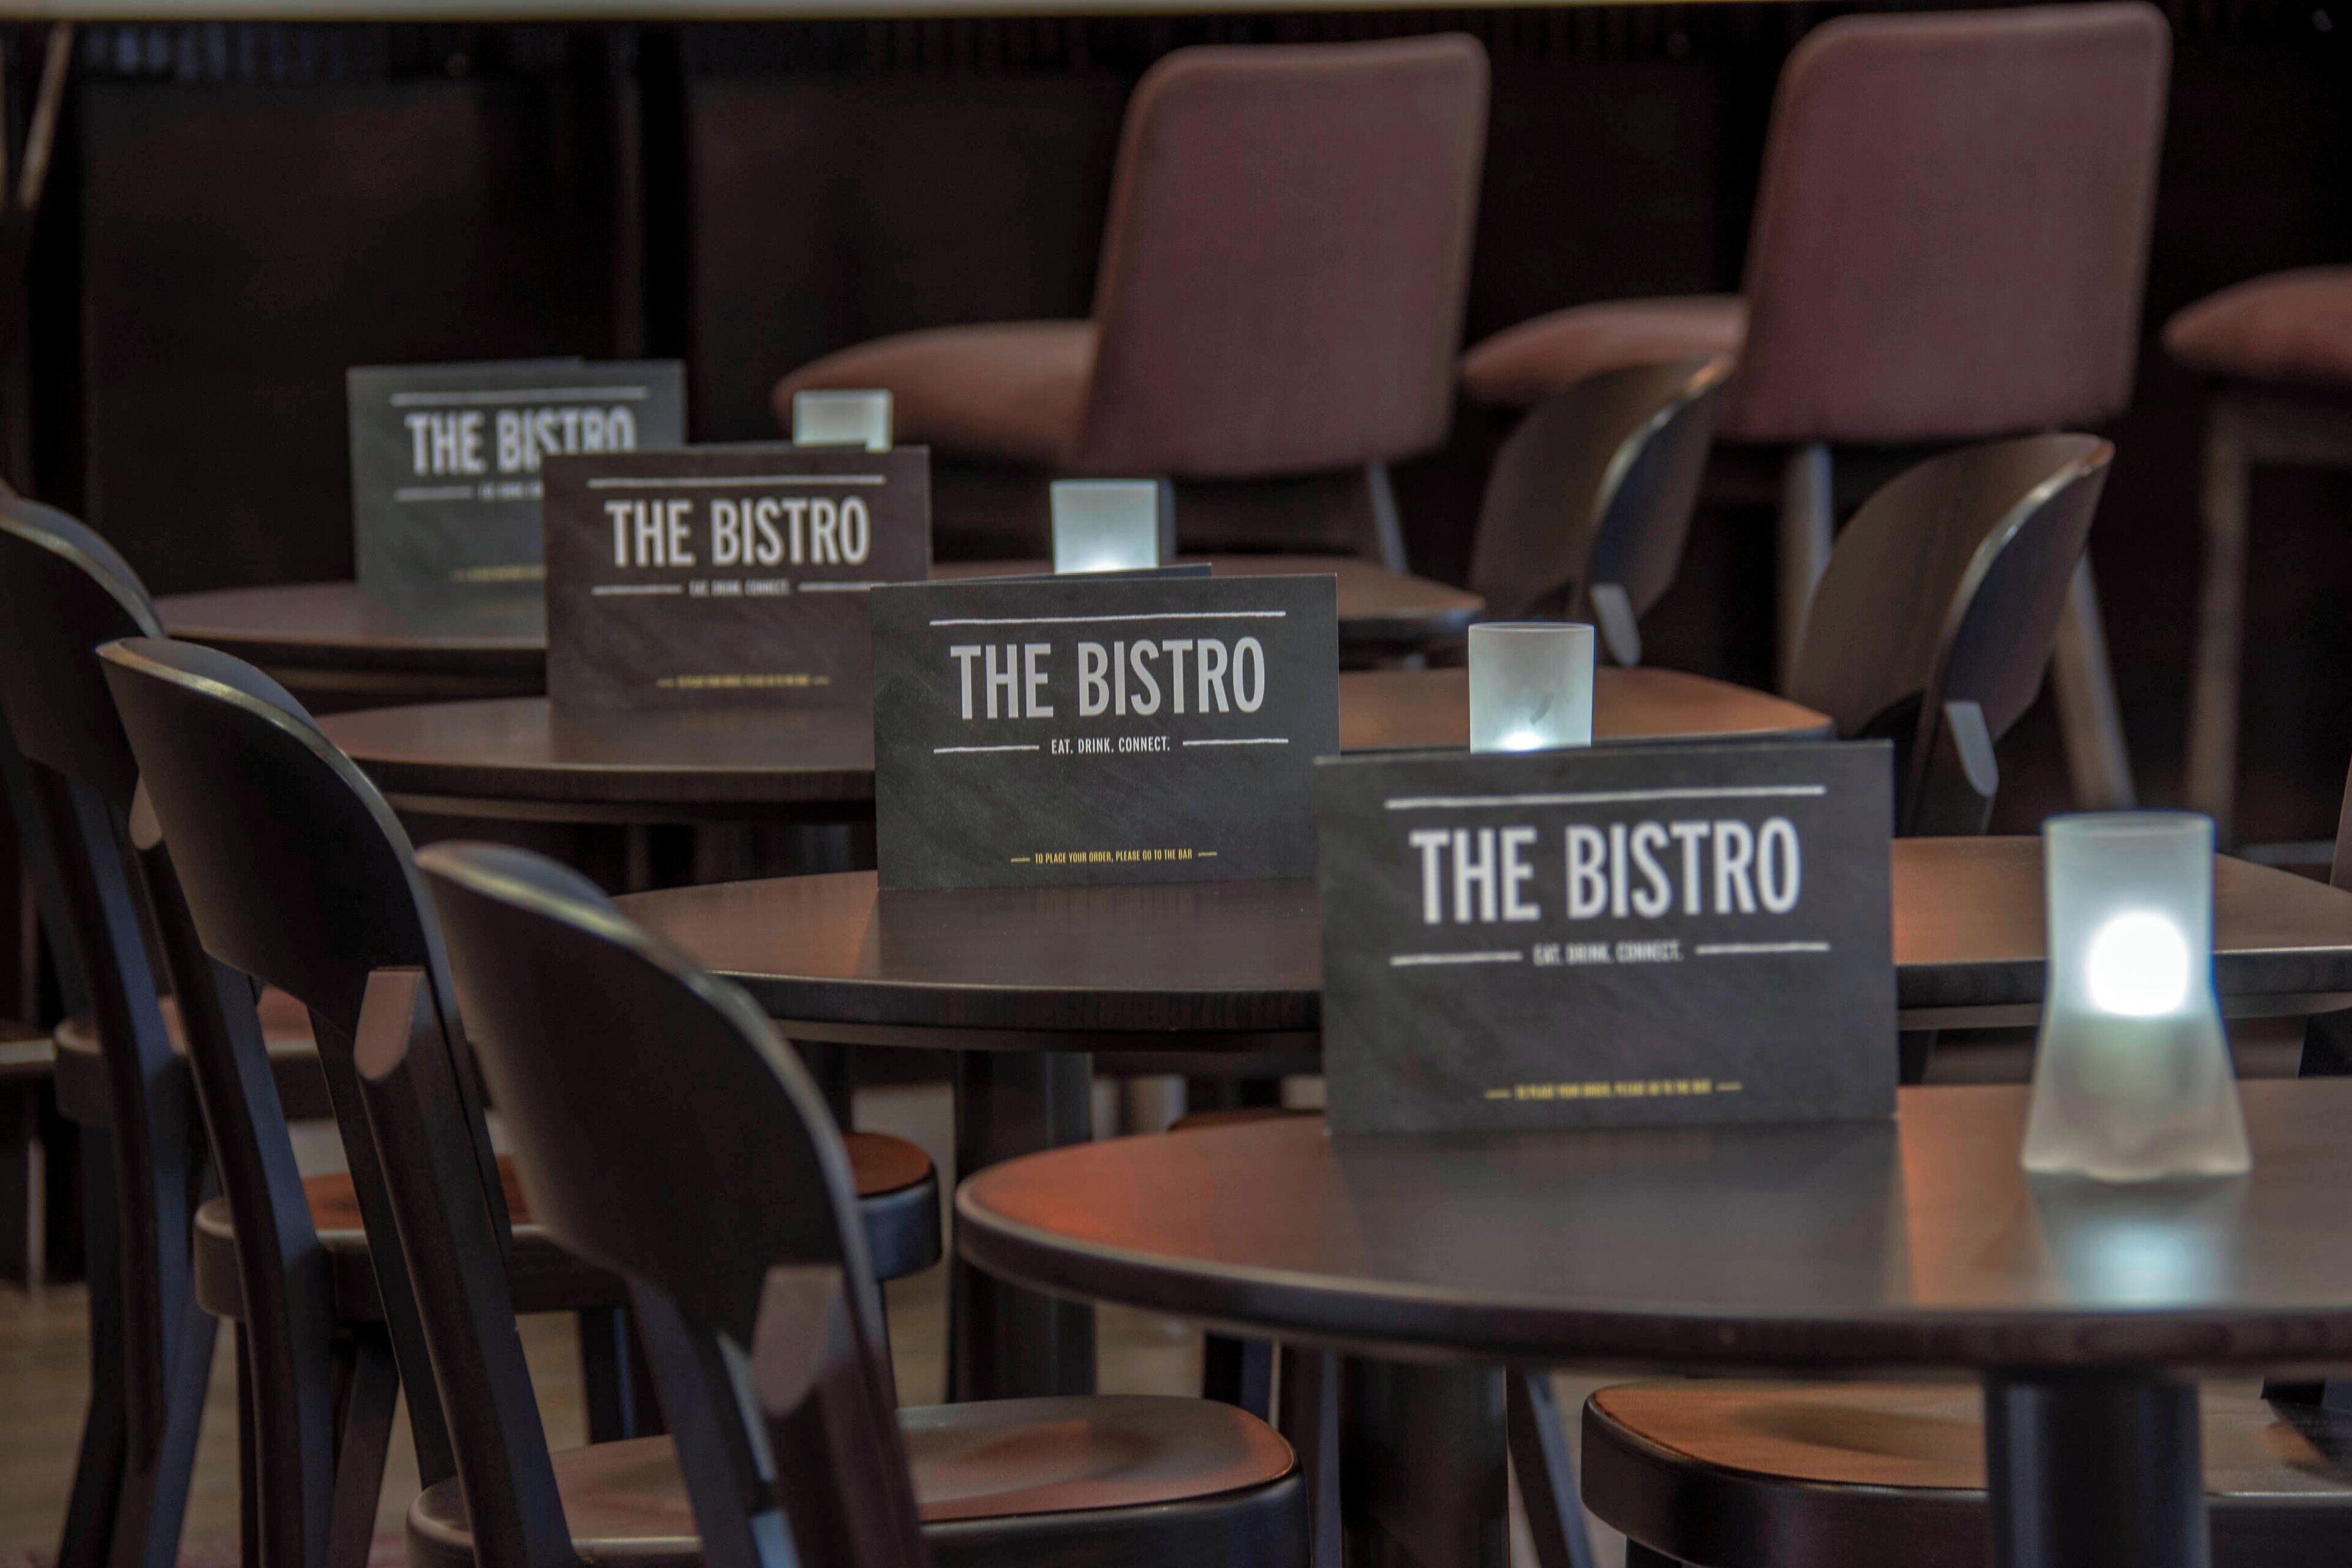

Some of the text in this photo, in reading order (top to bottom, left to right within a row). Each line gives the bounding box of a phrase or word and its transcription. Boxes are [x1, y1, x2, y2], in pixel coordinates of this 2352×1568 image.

[404, 405, 637, 475] THE BISTRO
[604, 496, 870, 568] THE BISTRO
[950, 636, 1266, 720] THE BISTRO
[1051, 736, 1170, 755] EAT. DRINK. CONNECT.
[1035, 847, 1192, 864] TO PLACE YOUR ORDER, PLEASE GO TO THE BAR
[1408, 816, 1803, 925] THE BISTRO
